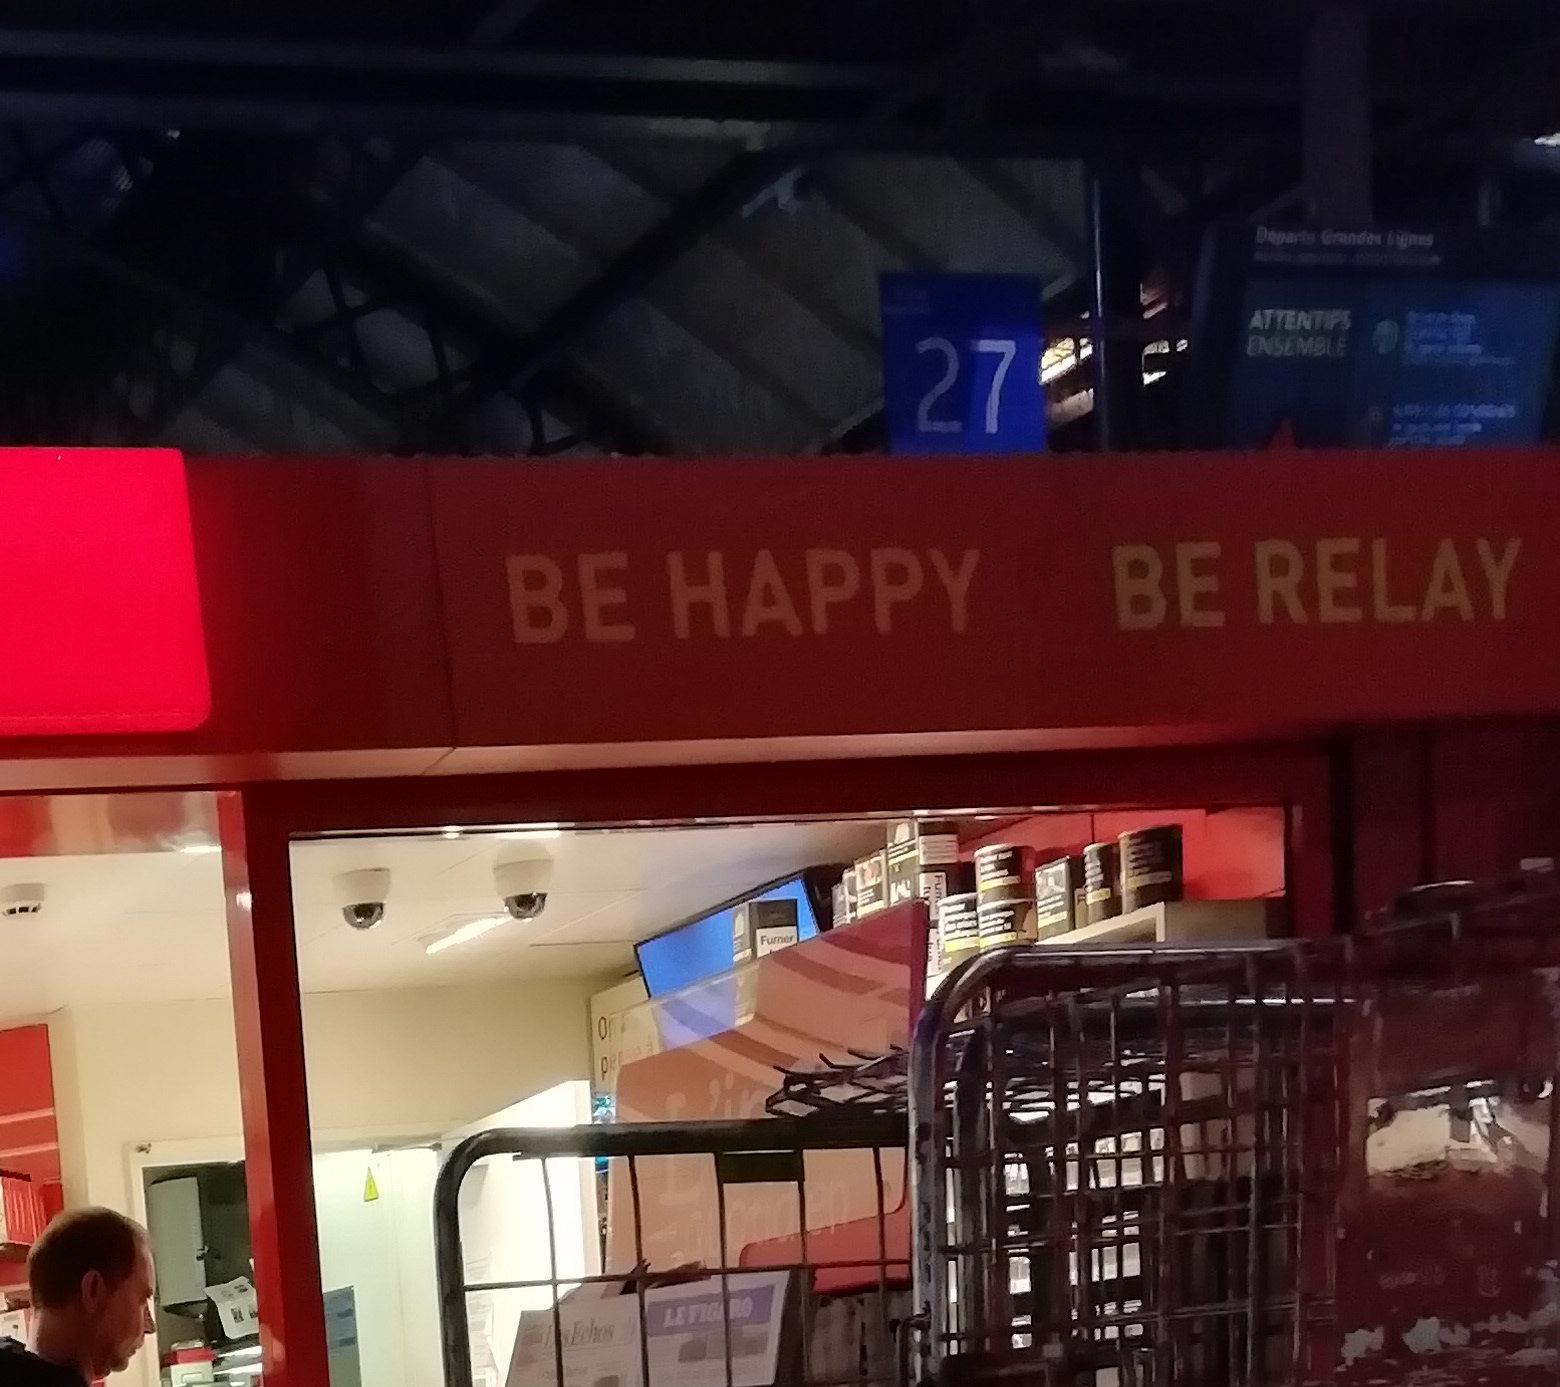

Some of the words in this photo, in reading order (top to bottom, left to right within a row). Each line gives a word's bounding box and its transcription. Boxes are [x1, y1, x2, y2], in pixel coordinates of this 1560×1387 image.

[1248, 309, 1352, 331] ATTENTIFS
[914, 336, 1017, 435] 27
[505, 551, 635, 645] BE
[666, 547, 981, 639] HAPPY
[1111, 541, 1227, 634] BE
[1254, 537, 1524, 628] RELAY
[545, 1324, 569, 1347] Ls
